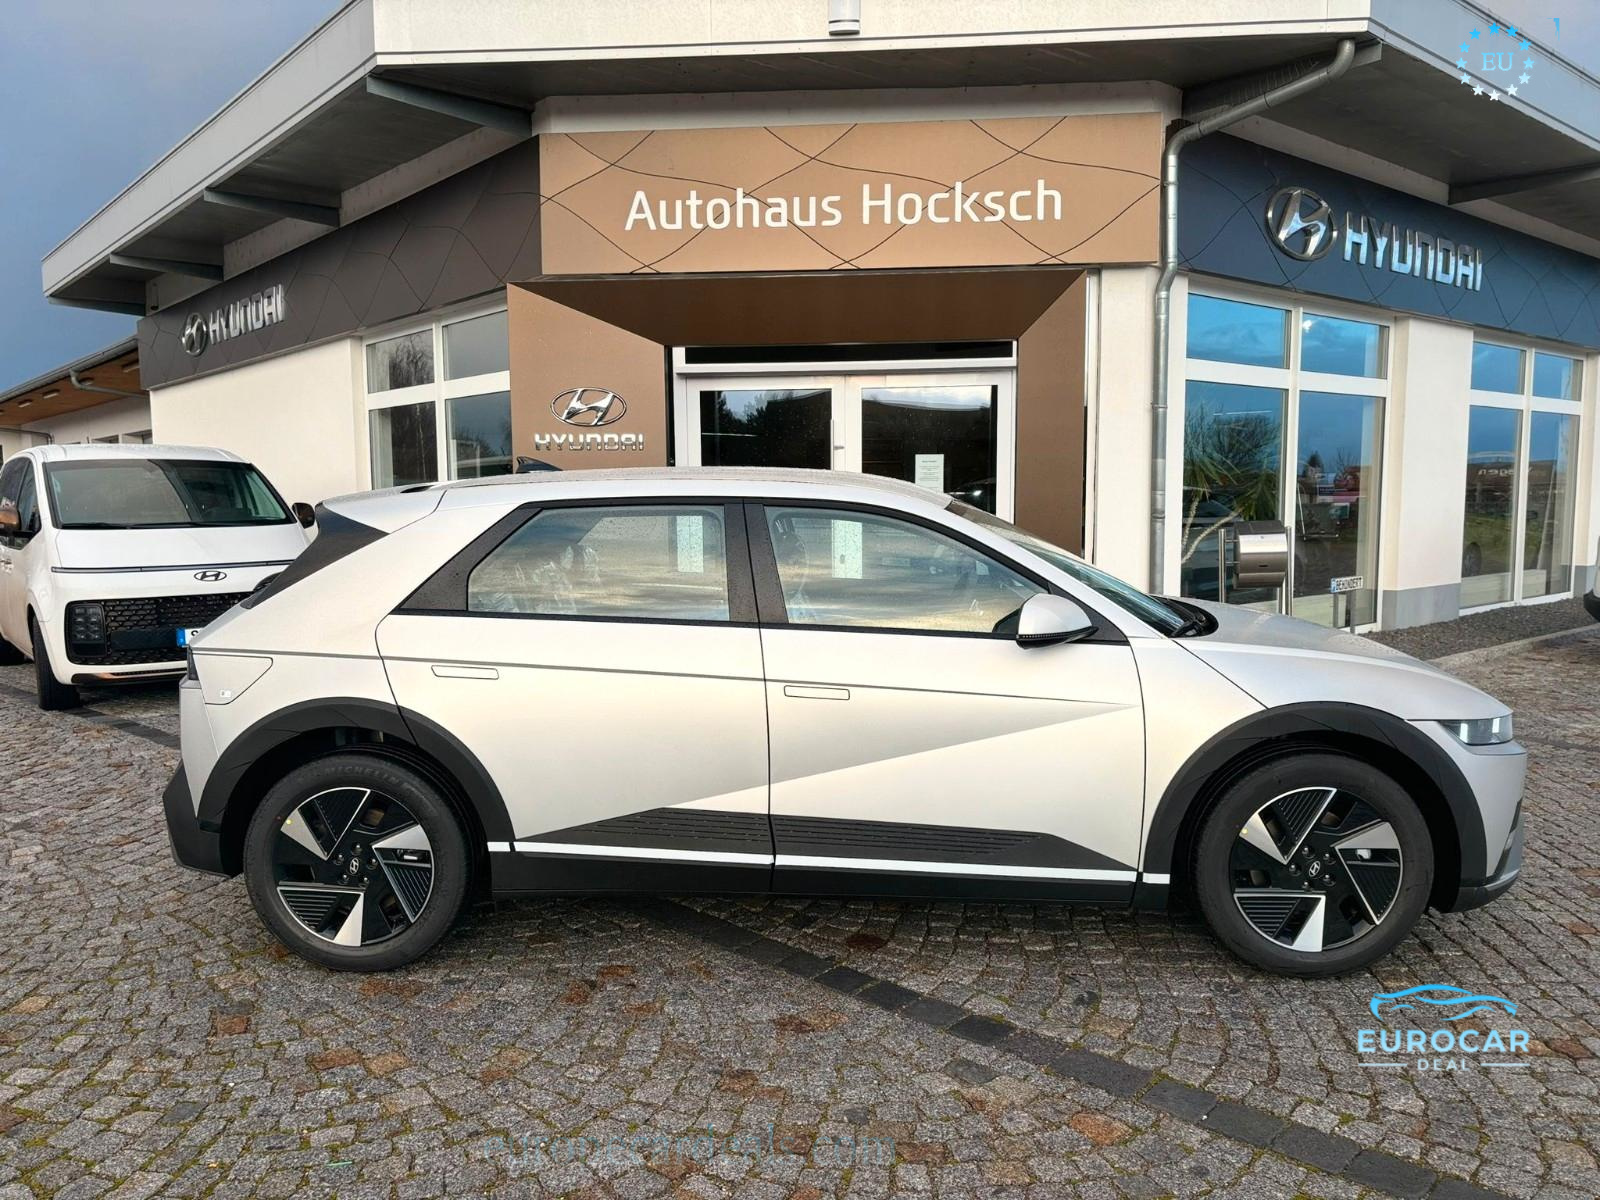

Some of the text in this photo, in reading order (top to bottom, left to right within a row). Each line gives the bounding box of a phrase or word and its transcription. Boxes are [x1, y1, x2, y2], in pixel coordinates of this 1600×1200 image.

[624, 179, 1062, 231] Autohaus Hocksch
[1343, 210, 1483, 292] HYUNDAI
[209, 284, 285, 345] HYUNDAI
[534, 432, 644, 451] HYUNDAI
